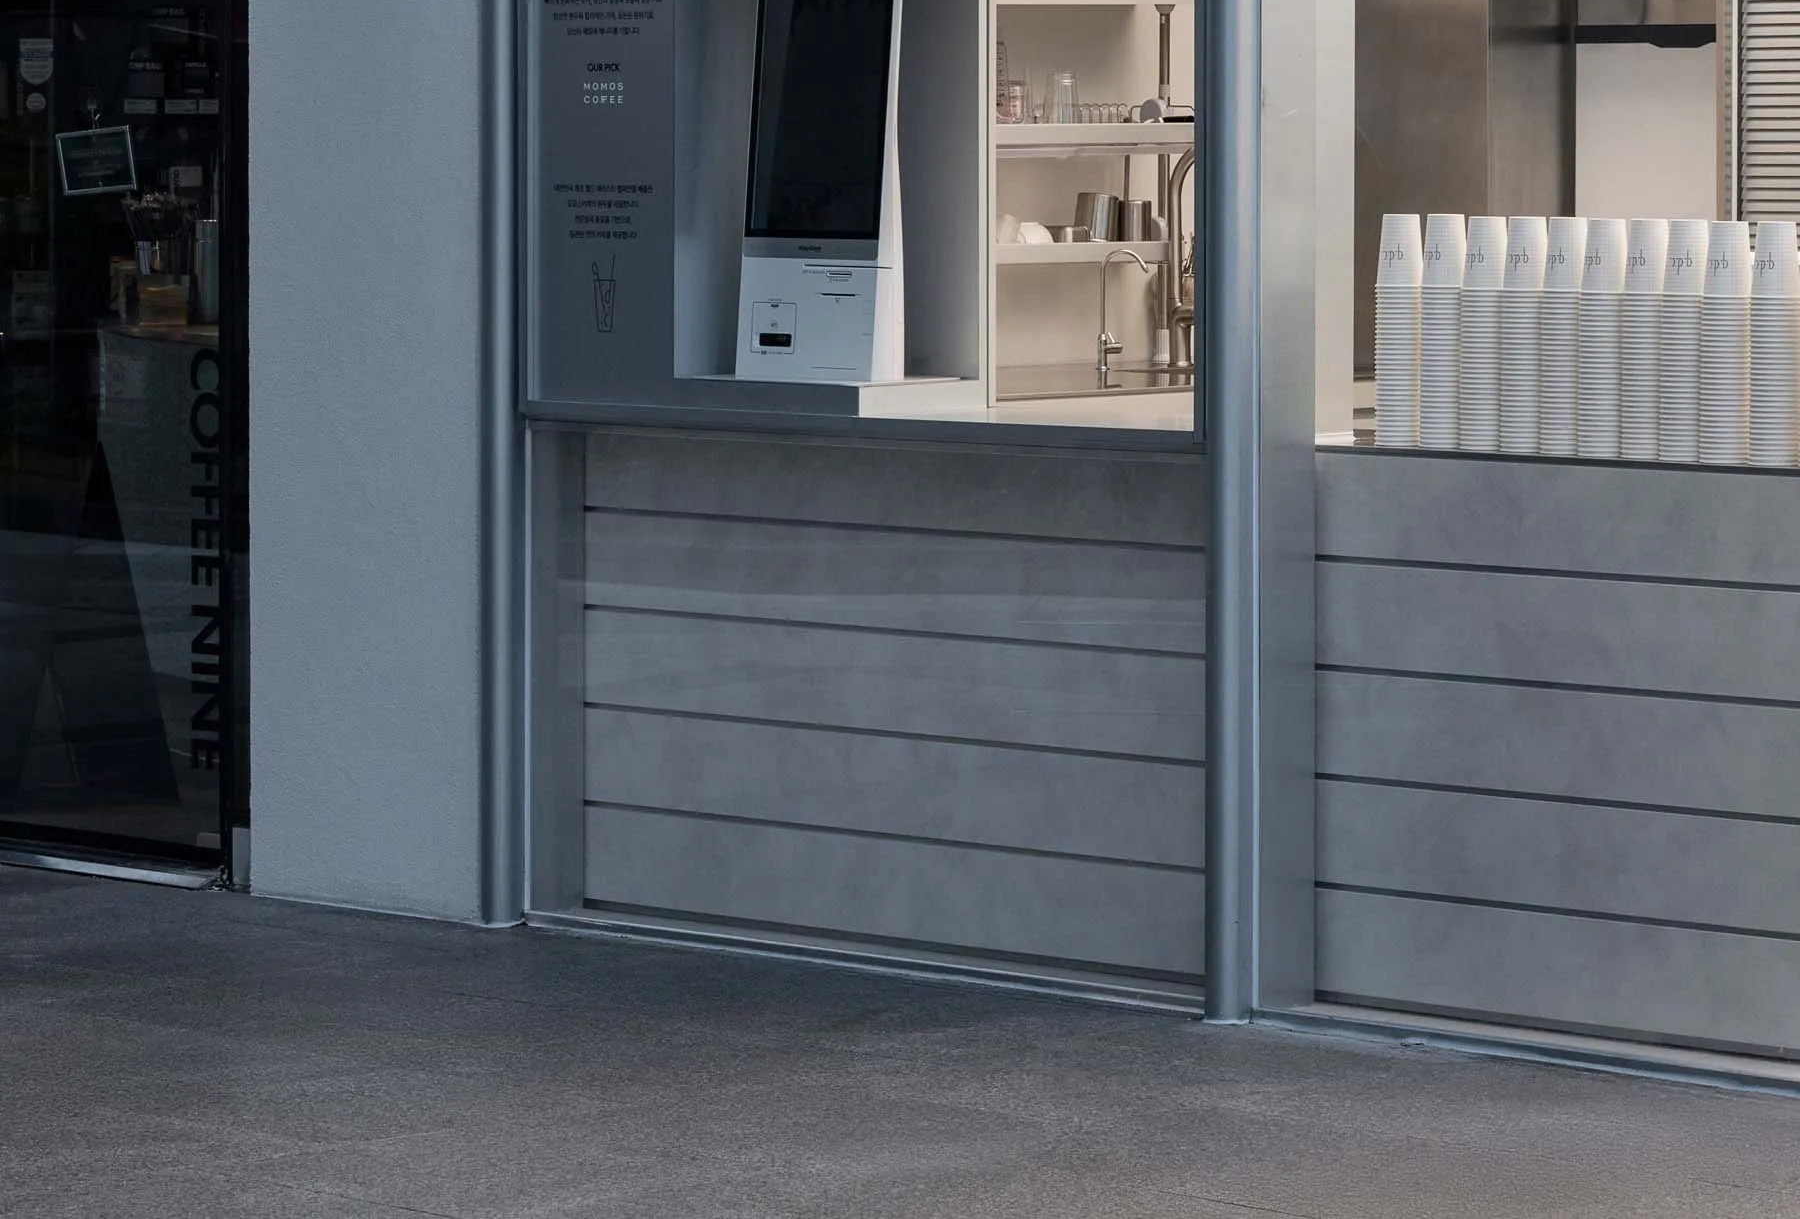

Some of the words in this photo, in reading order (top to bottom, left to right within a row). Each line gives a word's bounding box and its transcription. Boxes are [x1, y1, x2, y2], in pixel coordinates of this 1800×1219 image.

[587, 63, 603, 72] OUR
[603, 63, 621, 72] PICK
[583, 82, 624, 91] MOMOS
[583, 95, 624, 104] COFFEE
[190, 347, 220, 586] COFFEE
[190, 605, 220, 769] NINE
